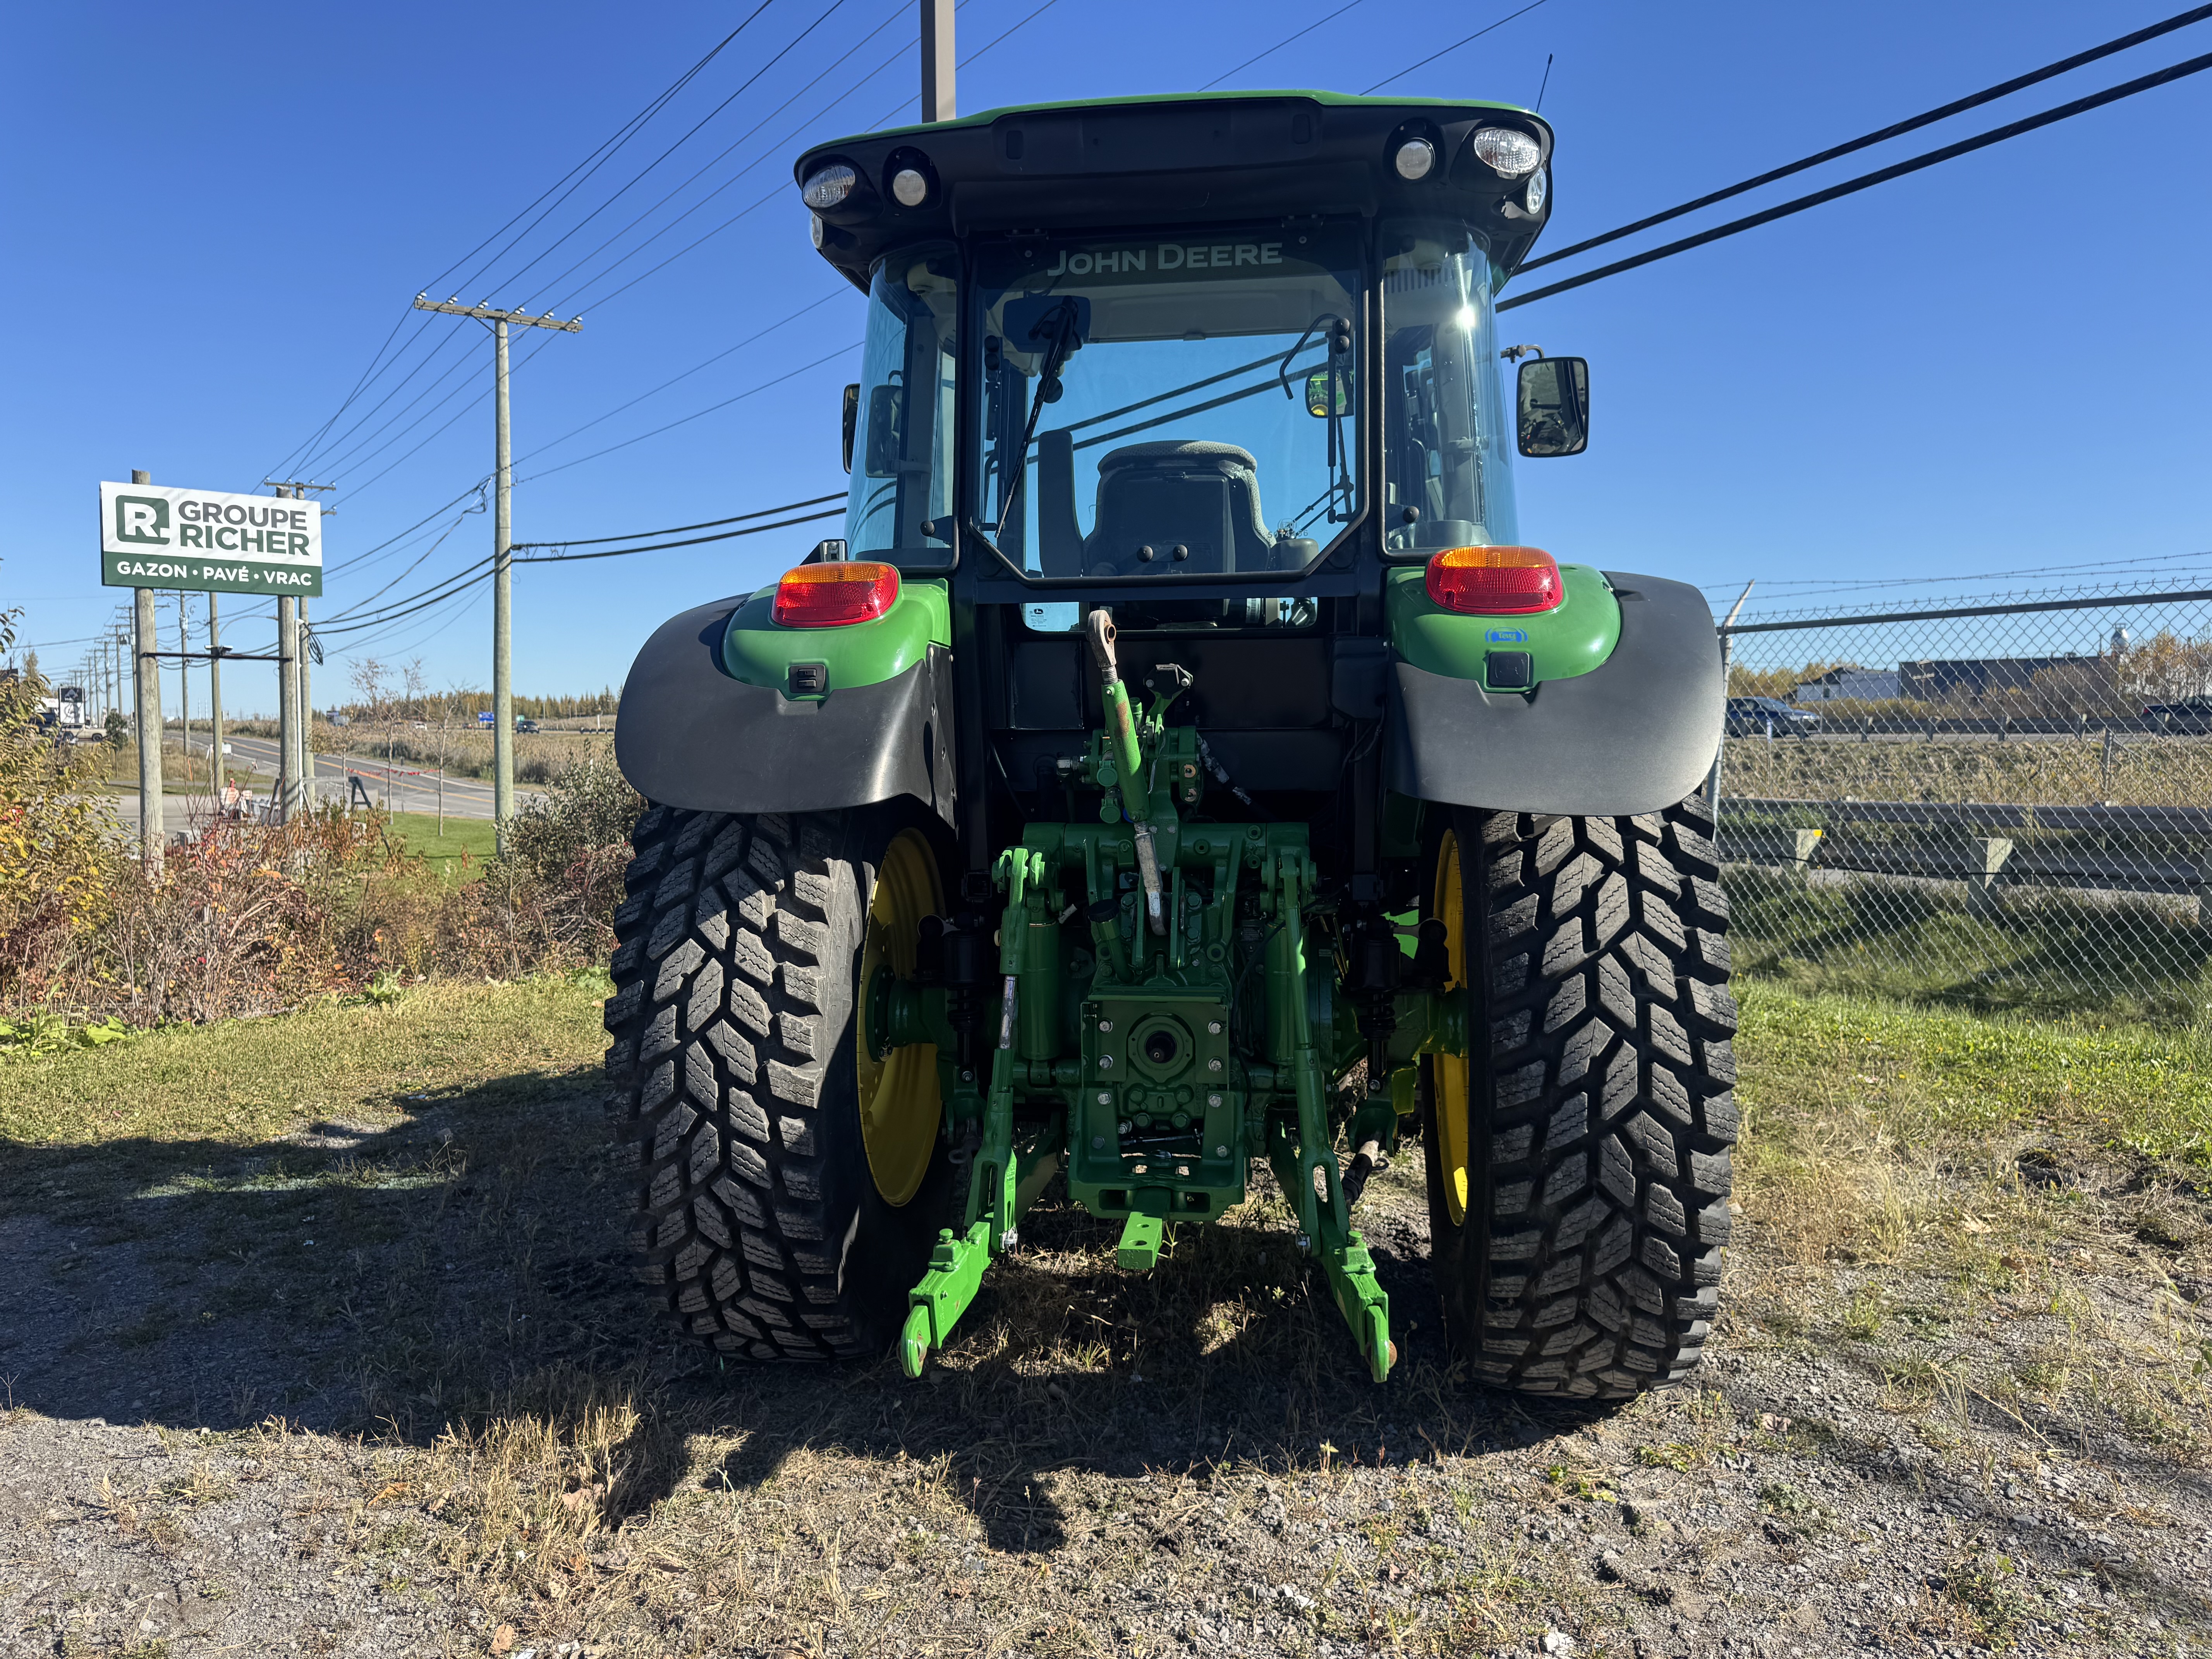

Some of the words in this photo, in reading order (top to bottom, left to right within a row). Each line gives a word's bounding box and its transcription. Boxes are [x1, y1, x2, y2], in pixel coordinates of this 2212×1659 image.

[1047, 250, 1146, 276] JOHN
[1158, 242, 1283, 270] DEERE
[178, 500, 307, 531] GROUPE
[180, 523, 310, 556] RICHER
[117, 561, 187, 579] GAZON
[203, 565, 249, 582] PAVÉ
[263, 570, 312, 586] VRAC
